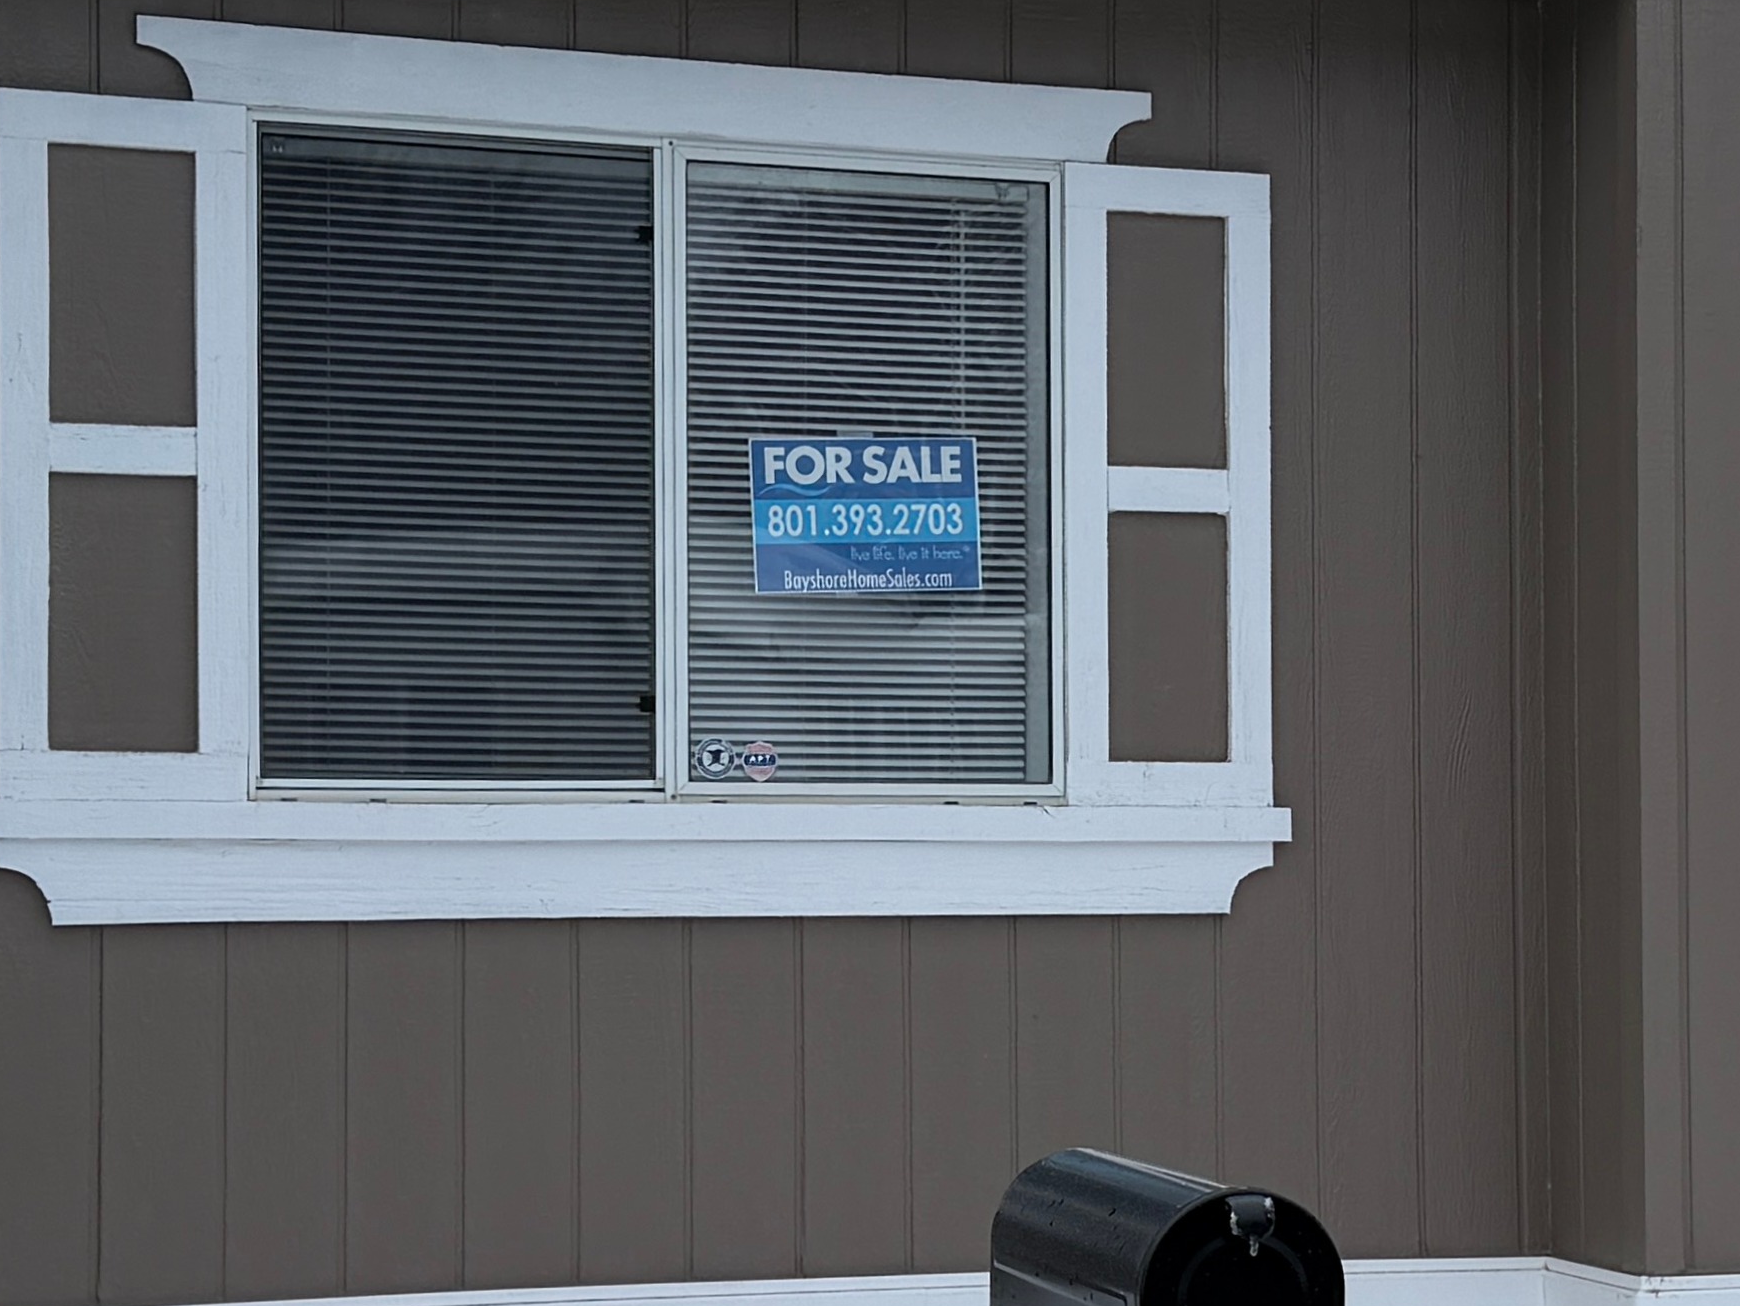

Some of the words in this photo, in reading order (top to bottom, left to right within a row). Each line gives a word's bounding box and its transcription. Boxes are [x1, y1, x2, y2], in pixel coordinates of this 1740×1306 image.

[763, 445, 856, 485] FOR
[861, 445, 963, 484] SALE
[767, 502, 964, 537] 801.393.2703
[850, 545, 870, 561] live
[898, 545, 918, 561] live
[920, 546, 930, 560] it
[784, 566, 953, 591] BayshoreHomeSales.com
